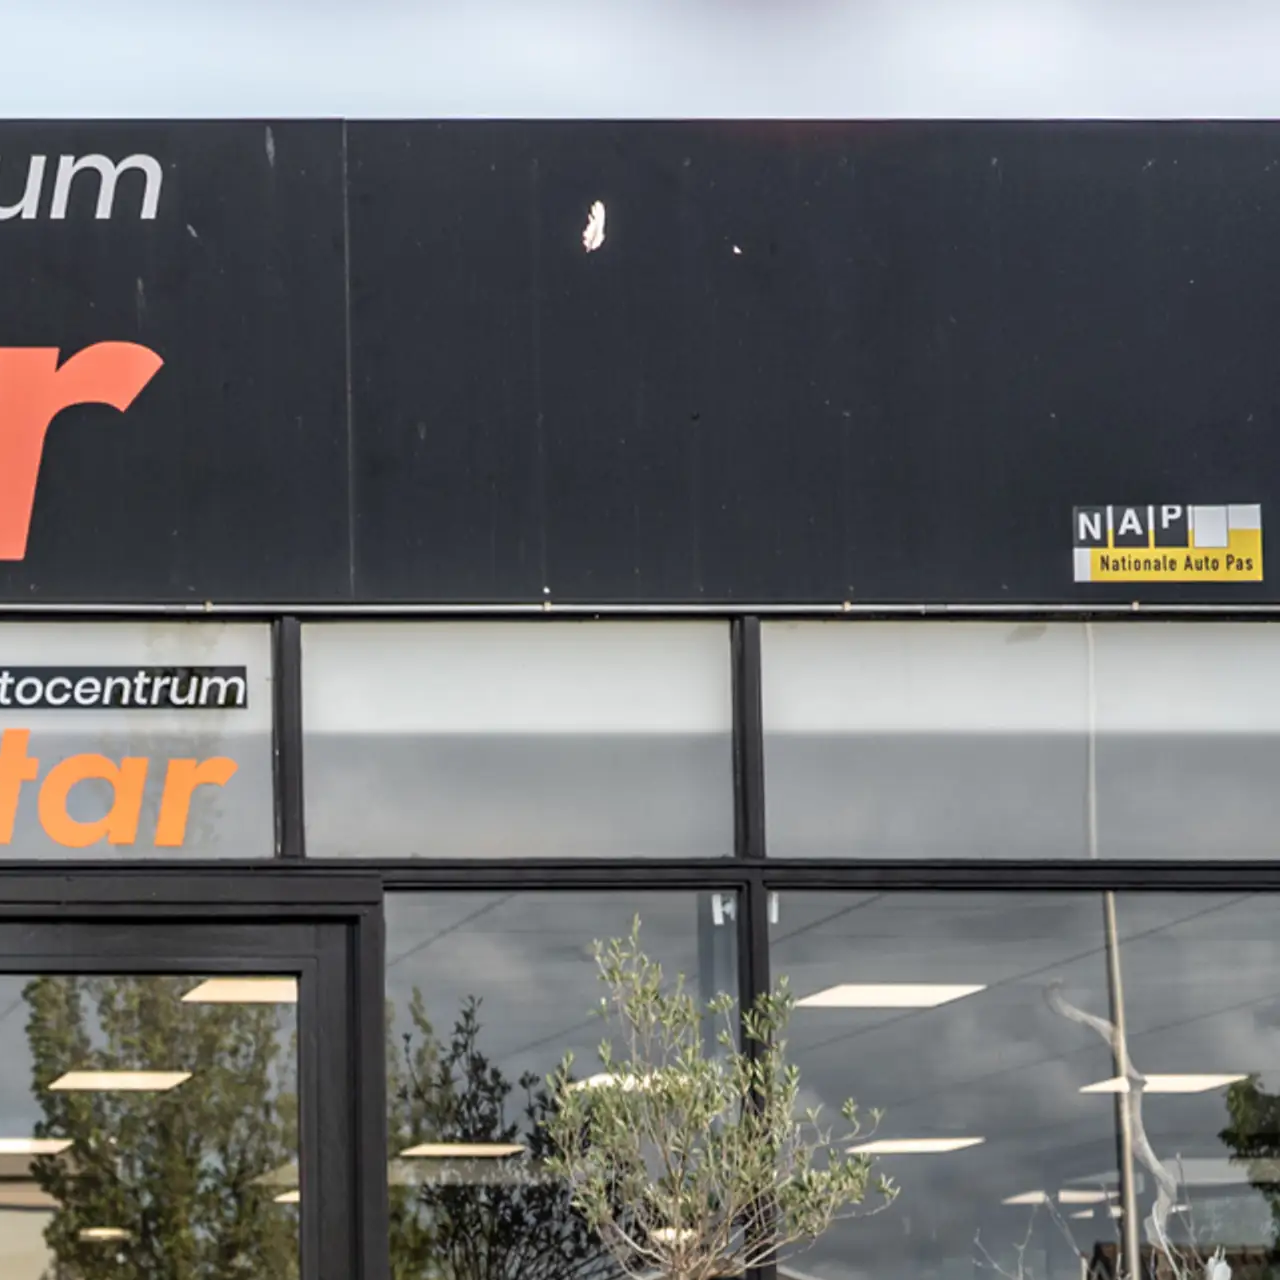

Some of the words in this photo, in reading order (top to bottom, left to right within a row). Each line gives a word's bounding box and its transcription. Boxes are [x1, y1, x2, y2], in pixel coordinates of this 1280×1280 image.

[1099, 554, 1178, 572] Nationale
[1183, 554, 1220, 571] Auto
[1225, 553, 1254, 571] Pas
